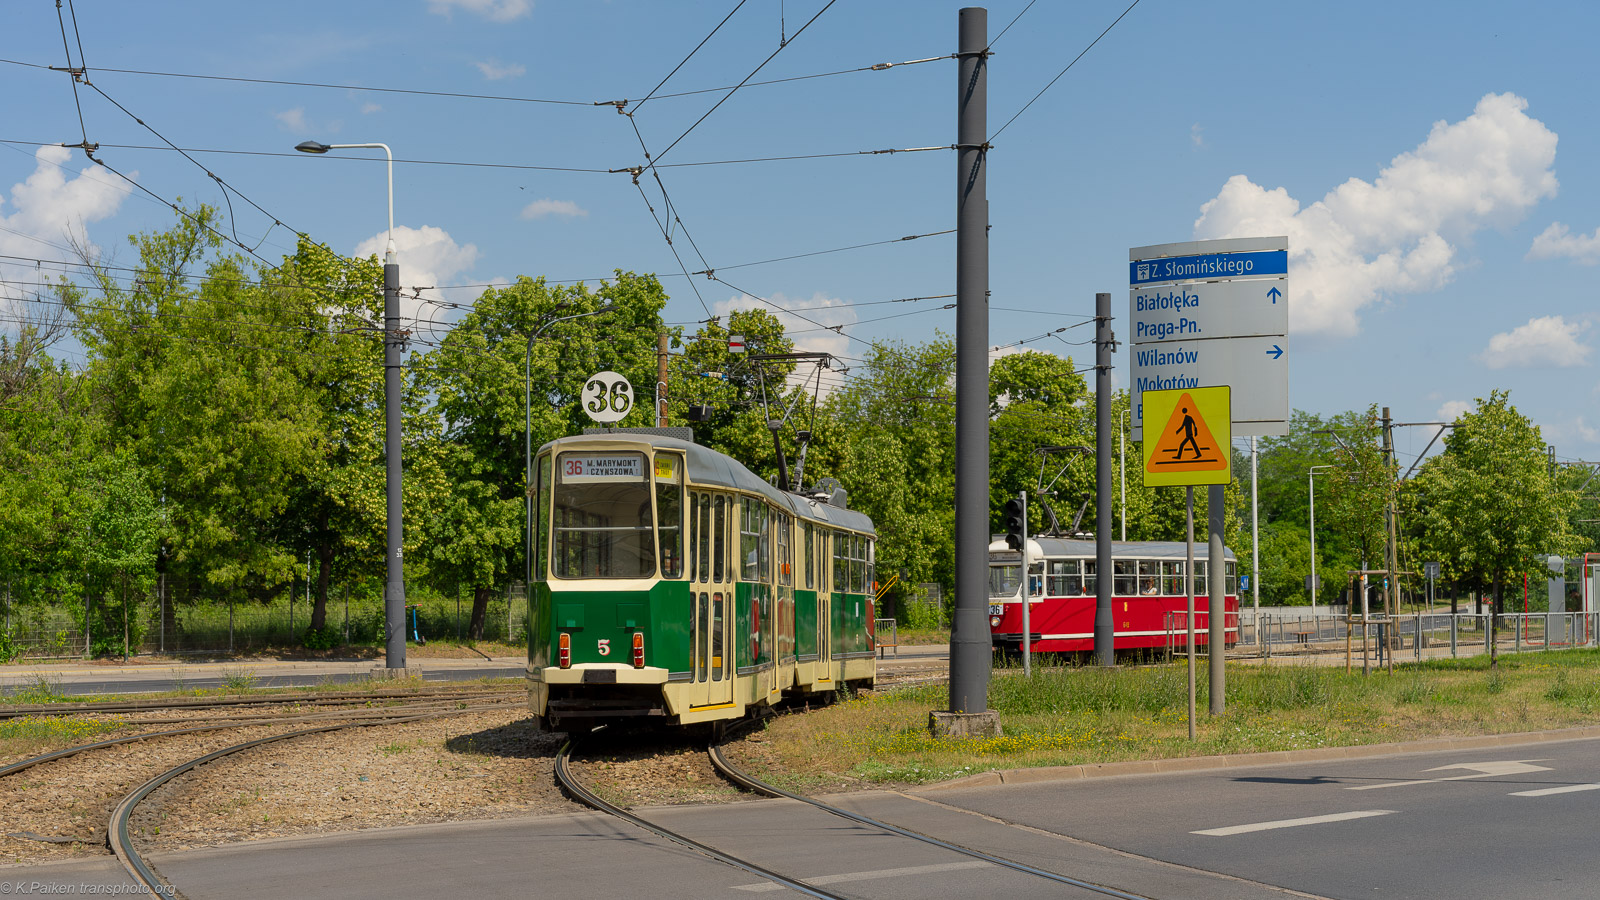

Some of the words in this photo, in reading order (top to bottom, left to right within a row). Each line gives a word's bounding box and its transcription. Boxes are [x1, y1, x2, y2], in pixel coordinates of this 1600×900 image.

[1151, 263, 1162, 278] Z.
[1165, 257, 1254, 278] Słomińskiego
[1136, 290, 1200, 313] Białołęka
[1137, 317, 1202, 340] Praga-Pn.
[1137, 347, 1199, 367] Wilanów
[1137, 373, 1199, 393] Mokotów
[586, 379, 630, 413] 36
[566, 460, 583, 475] 36
[590, 468, 634, 476] CZYNSZOWA
[597, 459, 638, 468] MARYMONT
[990, 605, 1000, 615] 36
[597, 638, 611, 656] 5
